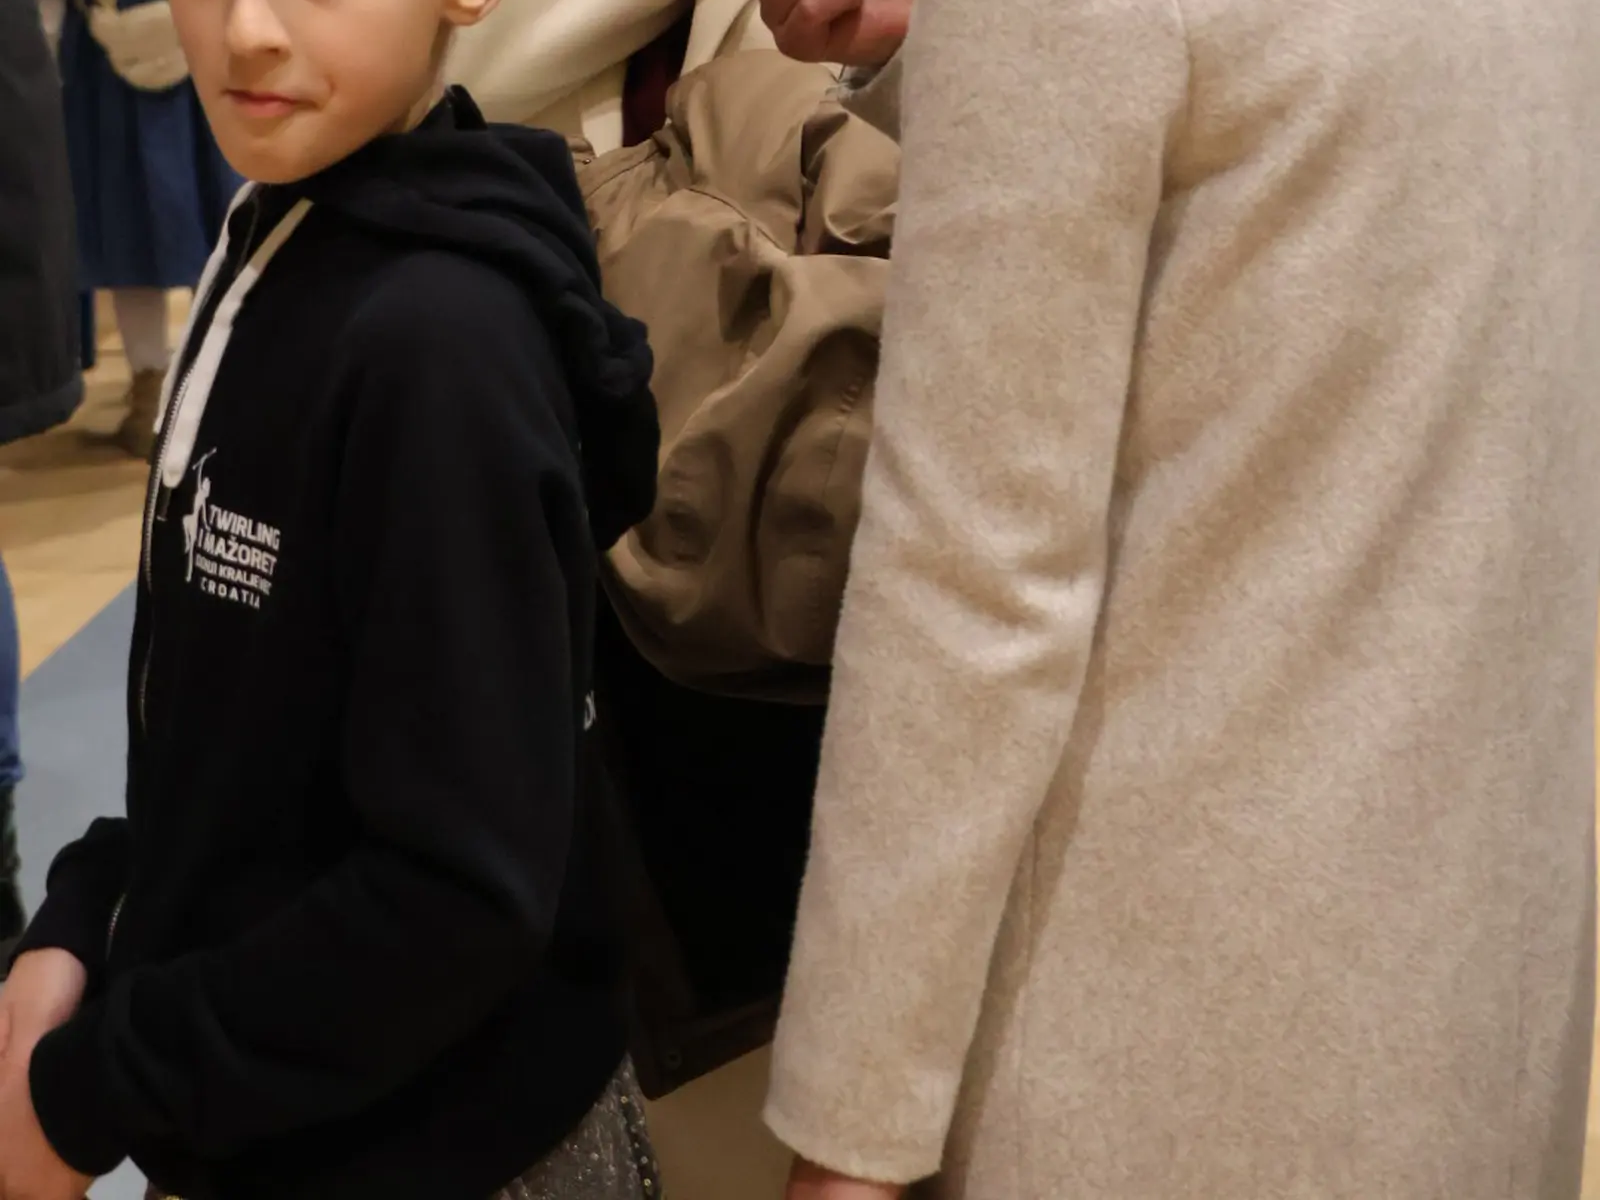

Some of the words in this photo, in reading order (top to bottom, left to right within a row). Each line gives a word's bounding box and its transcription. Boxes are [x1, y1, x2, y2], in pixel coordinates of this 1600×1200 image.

[208, 504, 281, 551] TWIRLING
[203, 532, 277, 575] MAŽORET
[200, 576, 261, 610] CROATIA
